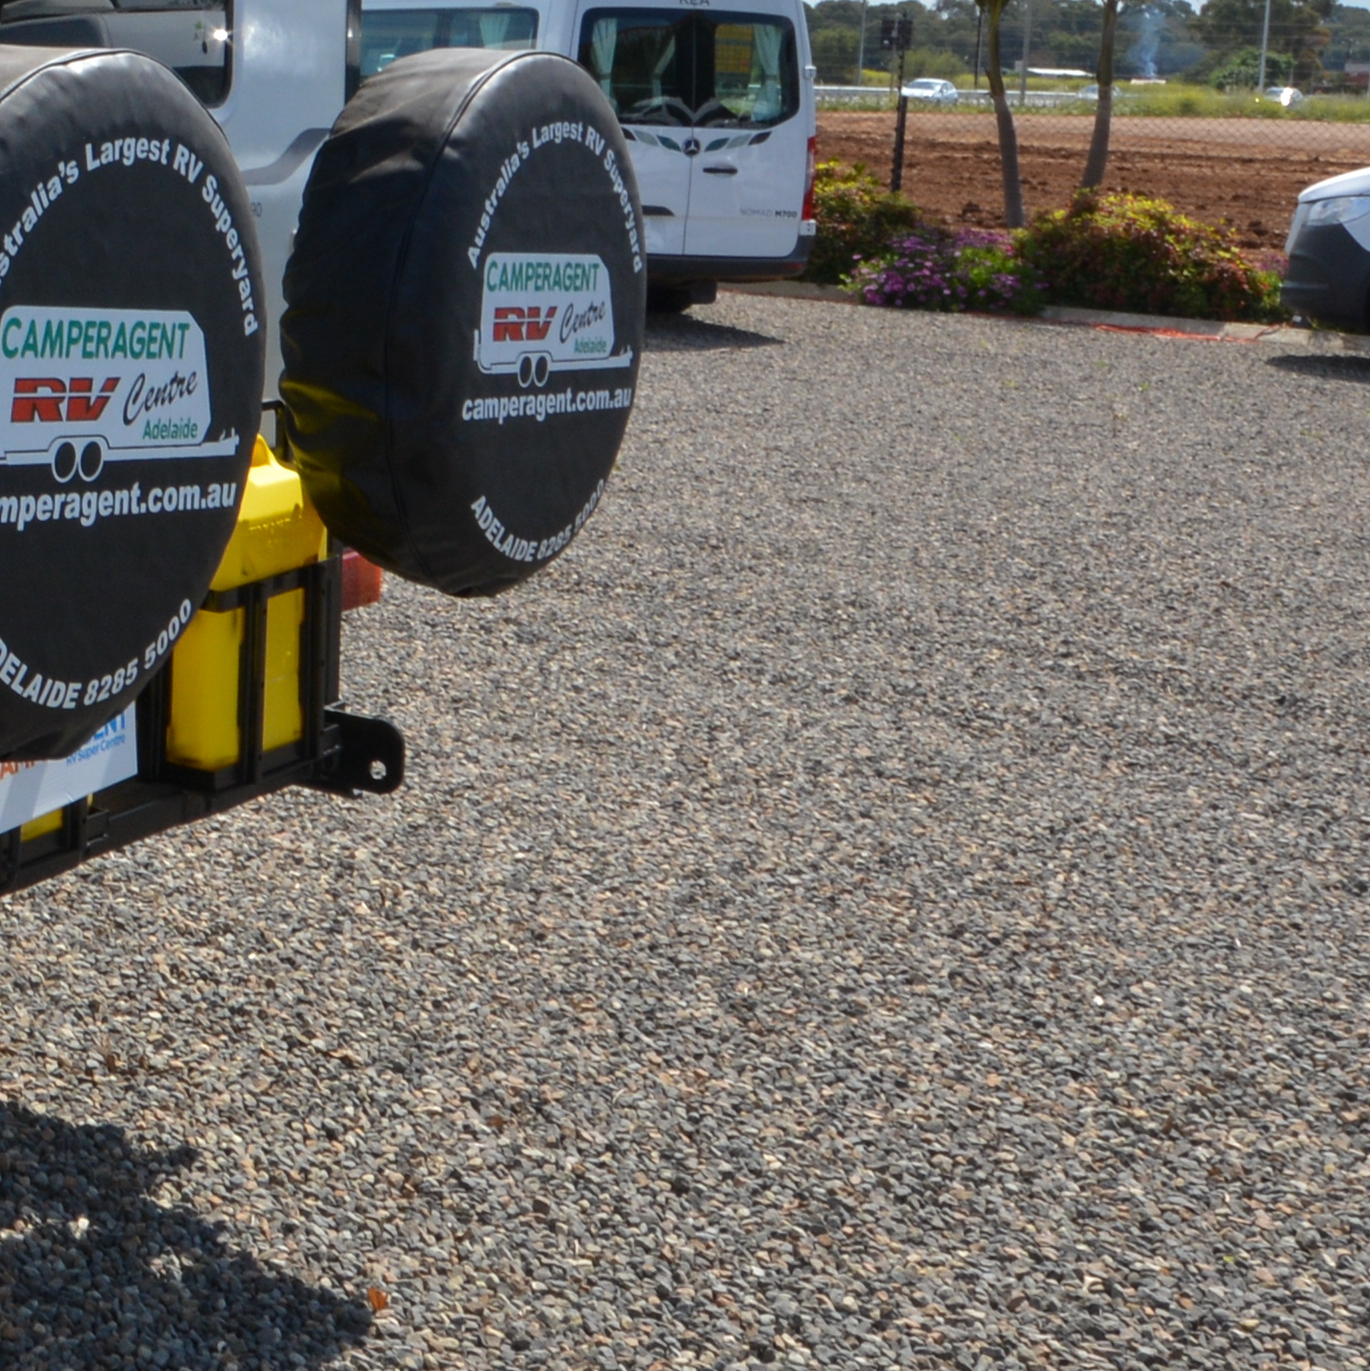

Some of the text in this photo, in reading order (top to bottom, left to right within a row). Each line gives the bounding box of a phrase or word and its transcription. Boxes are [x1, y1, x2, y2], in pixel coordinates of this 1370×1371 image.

[467, 121, 642, 274] Australia's Largest RV Superyard
[85, 137, 170, 172] Largest
[172, 143, 204, 183] RV
[201, 174, 258, 336] Superyard
[486, 261, 600, 292] CAMPERAGENT
[1, 317, 190, 360] CAMPERAGENT
[493, 301, 606, 344] RV Centre
[574, 336, 607, 354] Adelaide
[10, 370, 197, 426] RV Centre
[462, 386, 632, 425] camperagent.com.au
[142, 419, 198, 440] Adelaide
[470, 495, 538, 562] ADELAIDE
[83, 658, 138, 706] 8285
[144, 598, 192, 670] 5000
